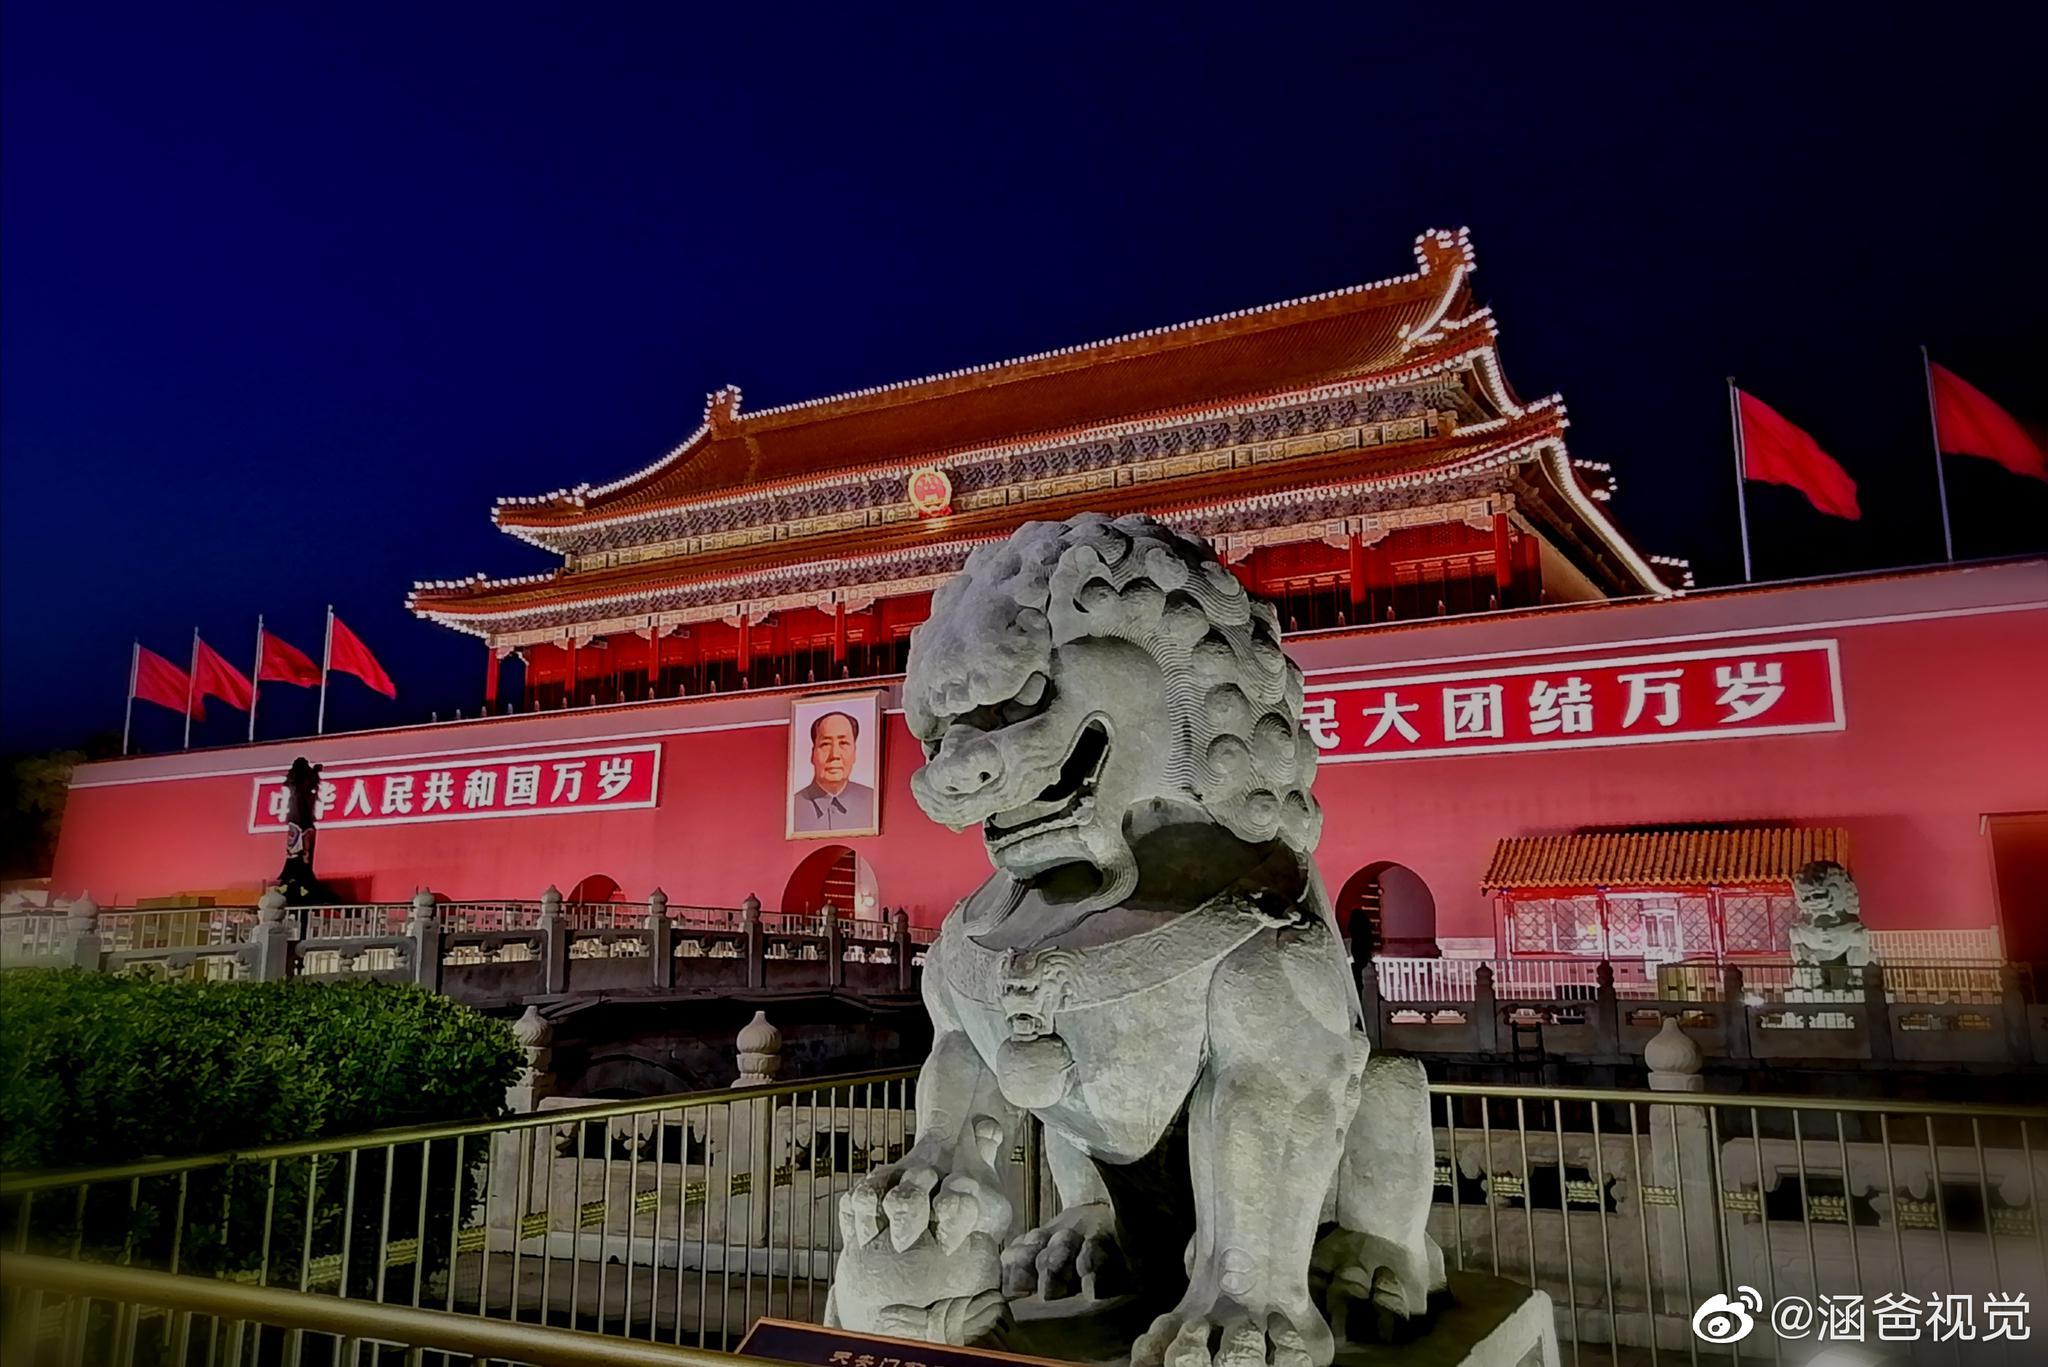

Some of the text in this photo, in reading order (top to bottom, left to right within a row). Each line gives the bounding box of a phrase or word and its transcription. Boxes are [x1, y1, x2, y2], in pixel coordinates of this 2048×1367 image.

[1299, 661, 1786, 749] 民大团结万岁
